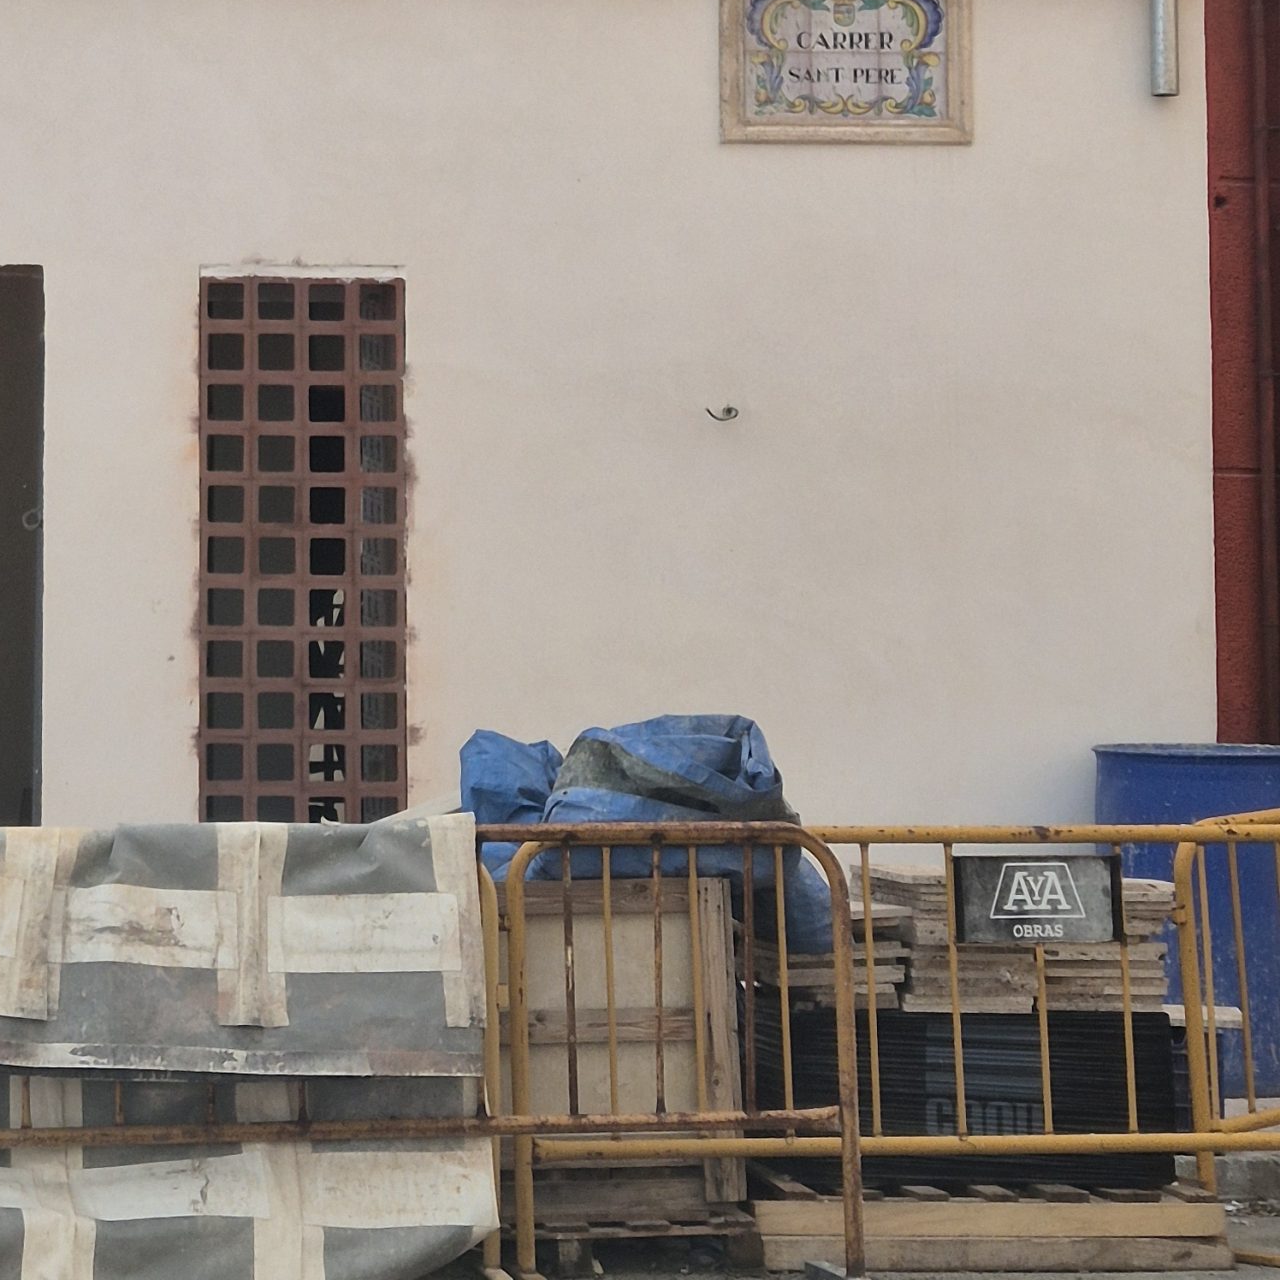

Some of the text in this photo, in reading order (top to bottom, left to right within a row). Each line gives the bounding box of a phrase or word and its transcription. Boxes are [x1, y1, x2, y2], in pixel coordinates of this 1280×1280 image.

[796, 31, 894, 50] CARRER
[788, 67, 903, 85] SANT PERE
[1013, 924, 1064, 938] OBRAS
